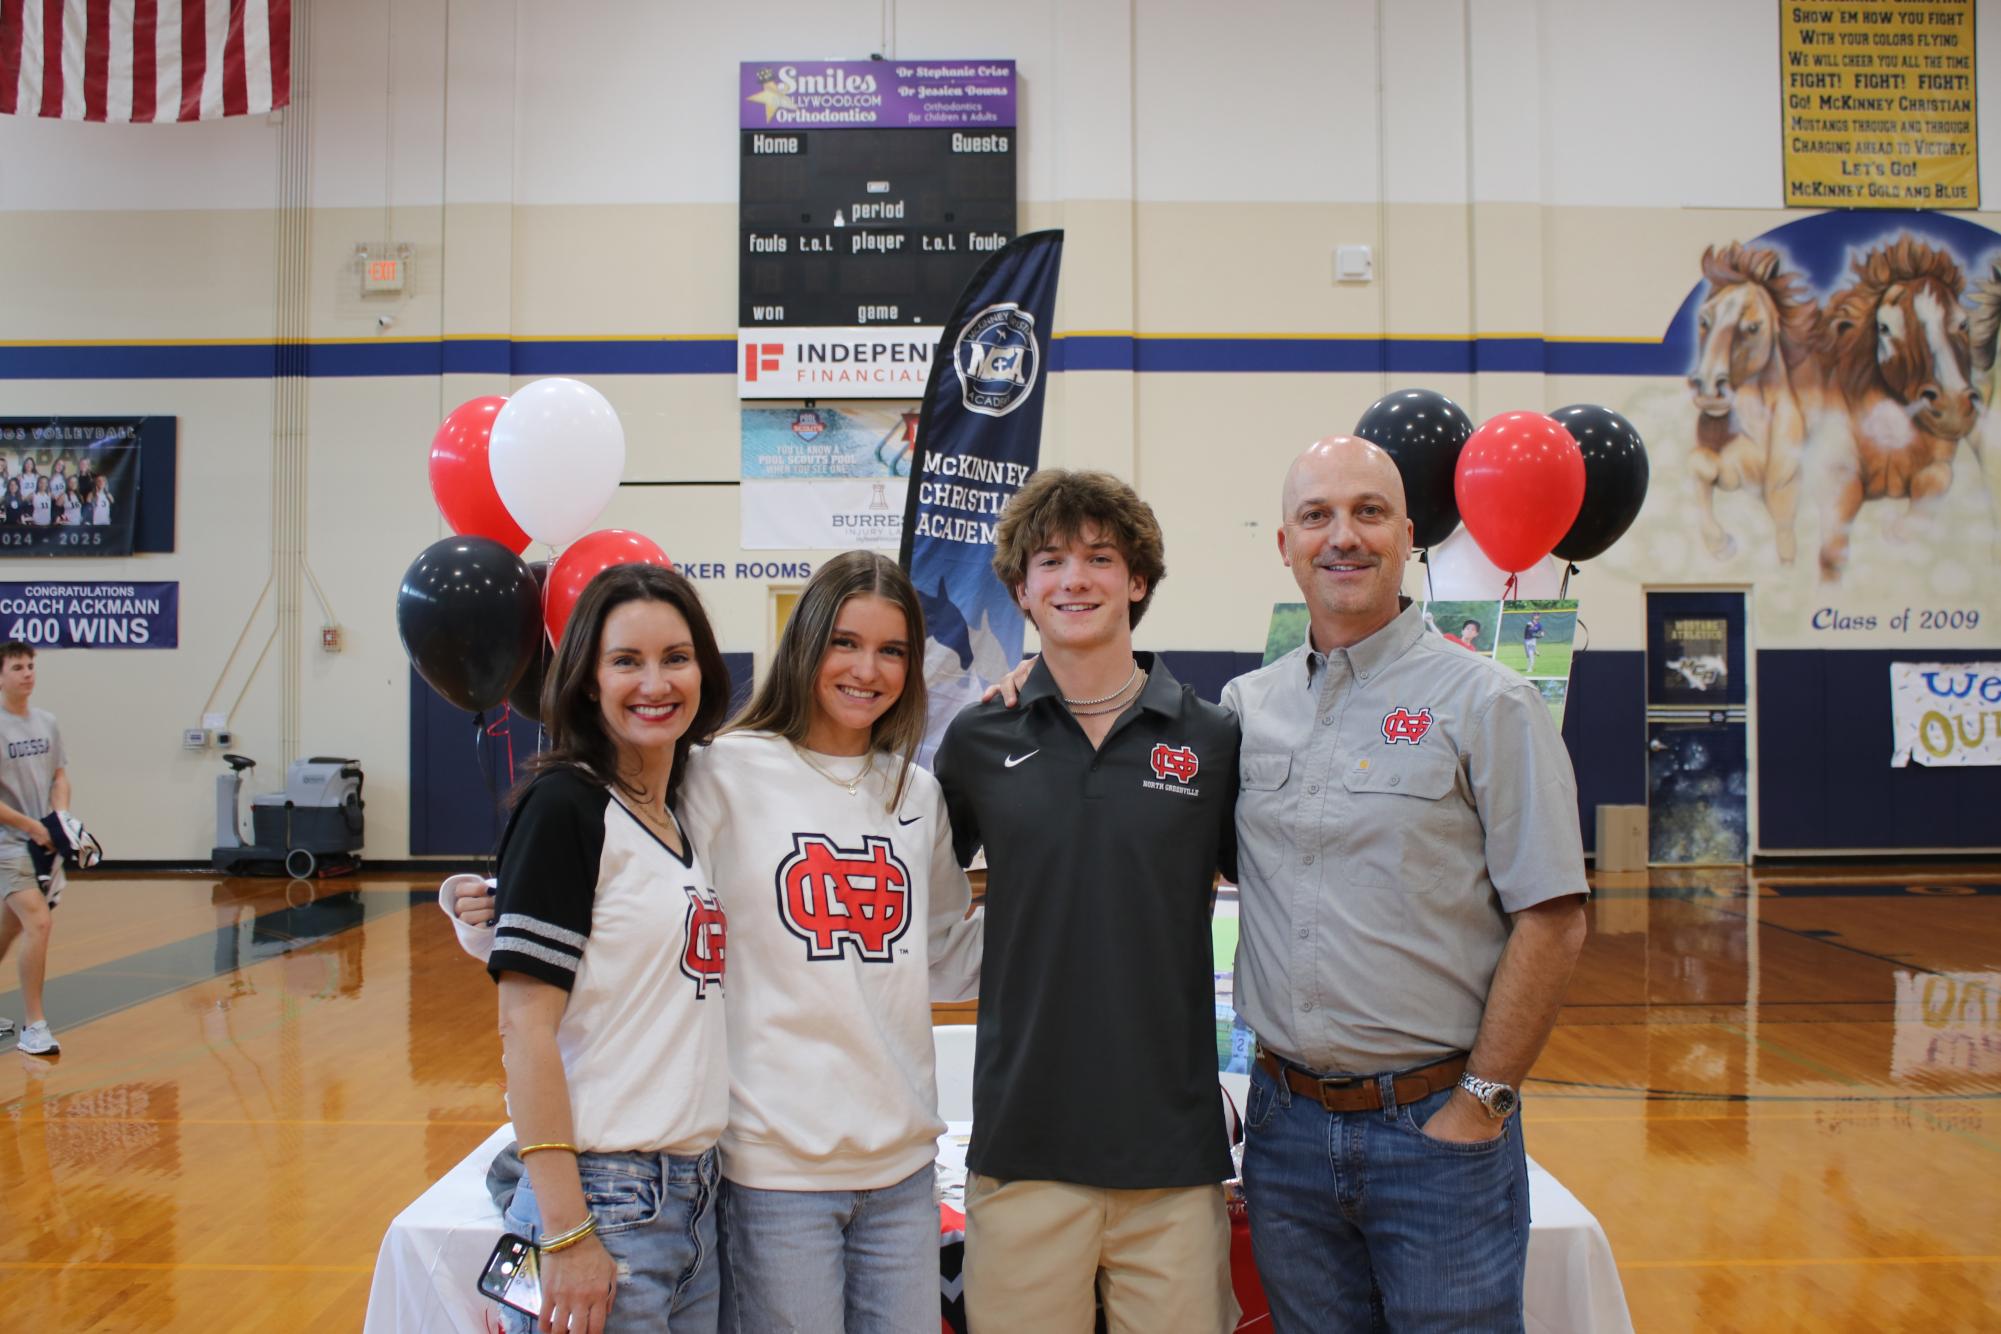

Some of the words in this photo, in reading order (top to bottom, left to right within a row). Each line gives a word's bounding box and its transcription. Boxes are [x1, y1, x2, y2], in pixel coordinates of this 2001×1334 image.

[1793, 8, 1833, 24] SHOW
[1862, 11, 1893, 24] HOW
[1899, 12, 1924, 24] YOU
[1928, 12, 1964, 26] FIGHT
[1799, 30, 1834, 45] WITH
[1839, 33, 1869, 45] YOUR
[1873, 33, 1914, 46] COLORS
[1917, 34, 1958, 47] FLYING
[1789, 51, 1809, 66] WE
[1812, 54, 1839, 67] WILL
[1842, 54, 1873, 67] CHEER
[1877, 55, 1898, 68] YOU
[1902, 55, 1920, 68] ALL
[1924, 56, 1943, 68] THE
[1946, 56, 1969, 69] TIME
[778, 66, 876, 94] Smiles
[896, 67, 914, 78] Dr
[916, 66, 976, 79] Stephanie
[1790, 73, 1841, 88] FIGHT!
[1855, 74, 1905, 89] FIGHT!
[1918, 75, 1969, 90] FIGHT!
[897, 86, 915, 97] Dr
[923, 102, 983, 112] Orthodontics
[1899, 96, 1970, 112] CHRISTIAN
[776, 108, 877, 122] Orthodontics
[924, 111, 959, 122] Children
[970, 111, 998, 121] Adults
[1792, 116, 1848, 131] MUSTANGS
[1853, 119, 1897, 132] THROUGH
[1901, 121, 1921, 133] AND
[1926, 121, 1969, 133] THROUGH
[753, 134, 798, 153] Home
[952, 133, 1008, 152] Guests
[1792, 138, 1850, 153] CHARGING
[1856, 142, 1893, 155] AHEAD
[1896, 142, 1911, 154] TO
[1904, 186, 1931, 198] AND
[1935, 183, 1968, 198] BLUE
[852, 201, 904, 222] period
[749, 234, 787, 252] fouls
[852, 232, 904, 253] player
[753, 305, 784, 321] won
[858, 305, 898, 323] game
[797, 343, 942, 363] INDEPEN
[797, 369, 925, 382] FINANCIAL
[31, 426, 136, 440] VOLLEYBALL
[759, 455, 784, 465] POOL
[788, 455, 828, 465] SCOUTS
[60, 533, 102, 545] 2025
[735, 562, 812, 579] ROOMS
[25, 586, 135, 597] CONGRATULATIONS
[0, 599, 64, 615] COACH
[68, 599, 160, 615] ACKMANN
[1812, 608, 1877, 630] Class
[1890, 608, 1910, 633] of
[1920, 610, 1980, 630] 2009
[9, 618, 60, 643] 400
[69, 618, 150, 643] WINS
[1143, 781, 1164, 790] NORTH
[1165, 784, 1200, 796] GREENVILLE
